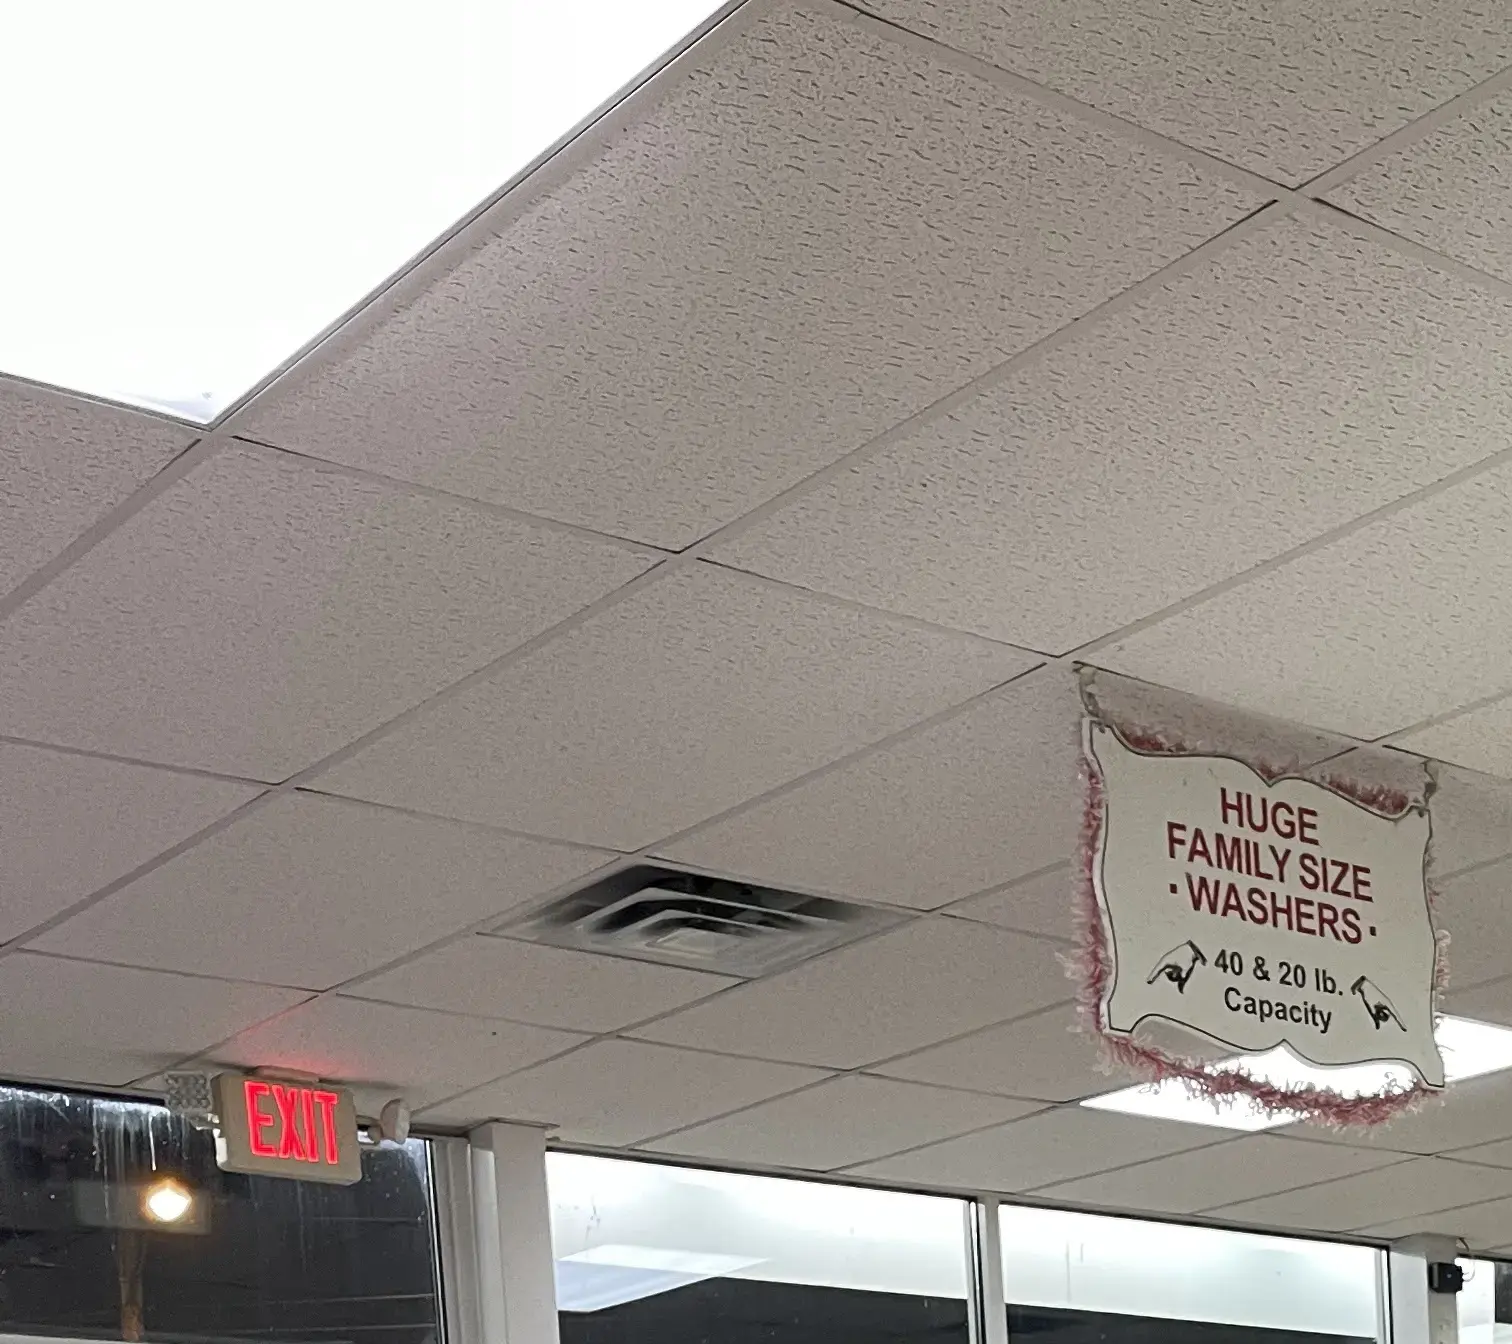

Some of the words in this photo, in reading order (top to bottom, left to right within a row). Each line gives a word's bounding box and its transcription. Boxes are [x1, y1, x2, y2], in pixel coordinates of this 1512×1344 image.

[1220, 787, 1320, 847] HUGE
[1166, 820, 1292, 884] FAMILY
[1299, 852, 1375, 903] SIZE
[1185, 871, 1363, 945] WASHERS
[1214, 948, 1243, 977] 40
[1252, 955, 1271, 982] &
[1278, 961, 1306, 989] 20
[1314, 967, 1344, 997] lb.
[1224, 986, 1332, 1034] Capacity
[243, 1080, 340, 1165] EXIT
